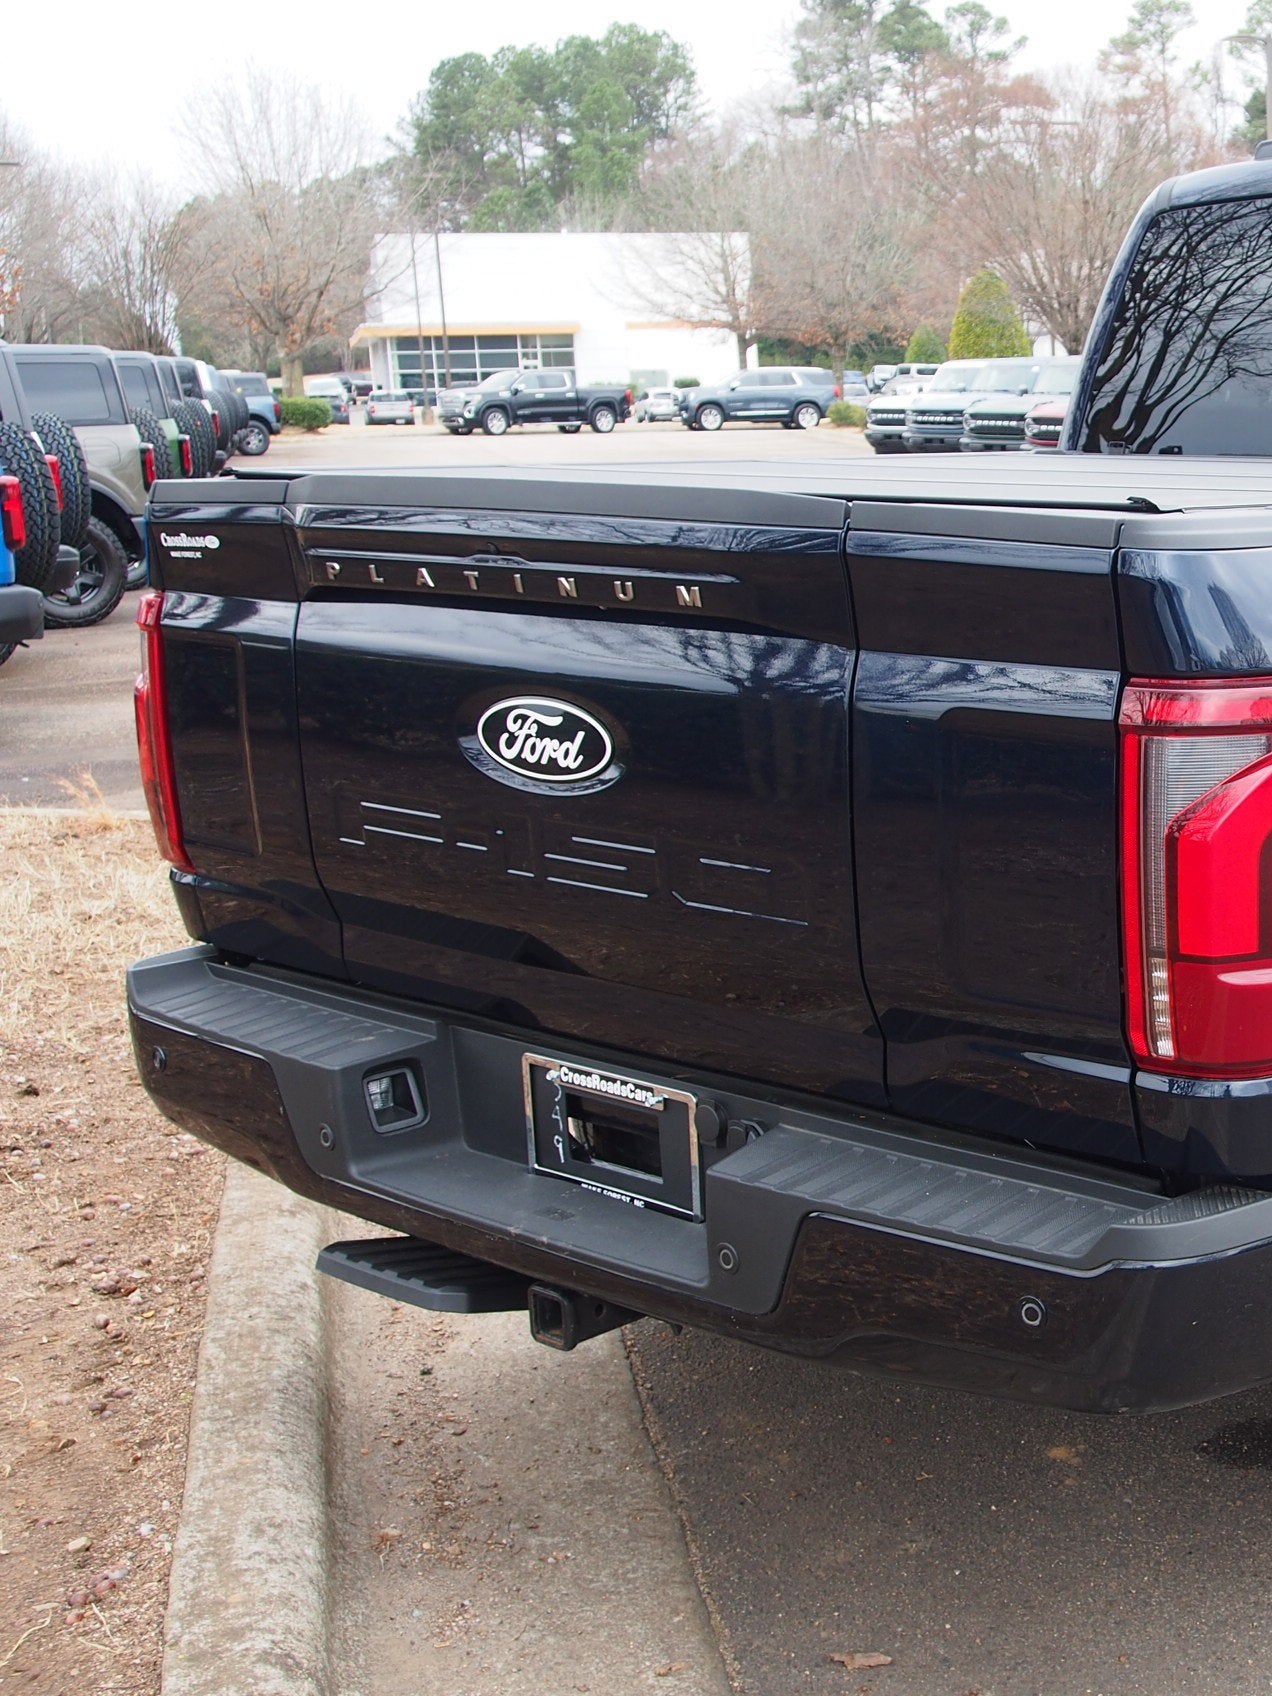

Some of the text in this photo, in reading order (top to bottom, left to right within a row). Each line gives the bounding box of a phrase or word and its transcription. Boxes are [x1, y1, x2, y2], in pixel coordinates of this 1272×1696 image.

[325, 561, 704, 608] PLATINUM
[498, 707, 585, 771] Ford
[560, 1067, 654, 1102] CrossRoadsCars
